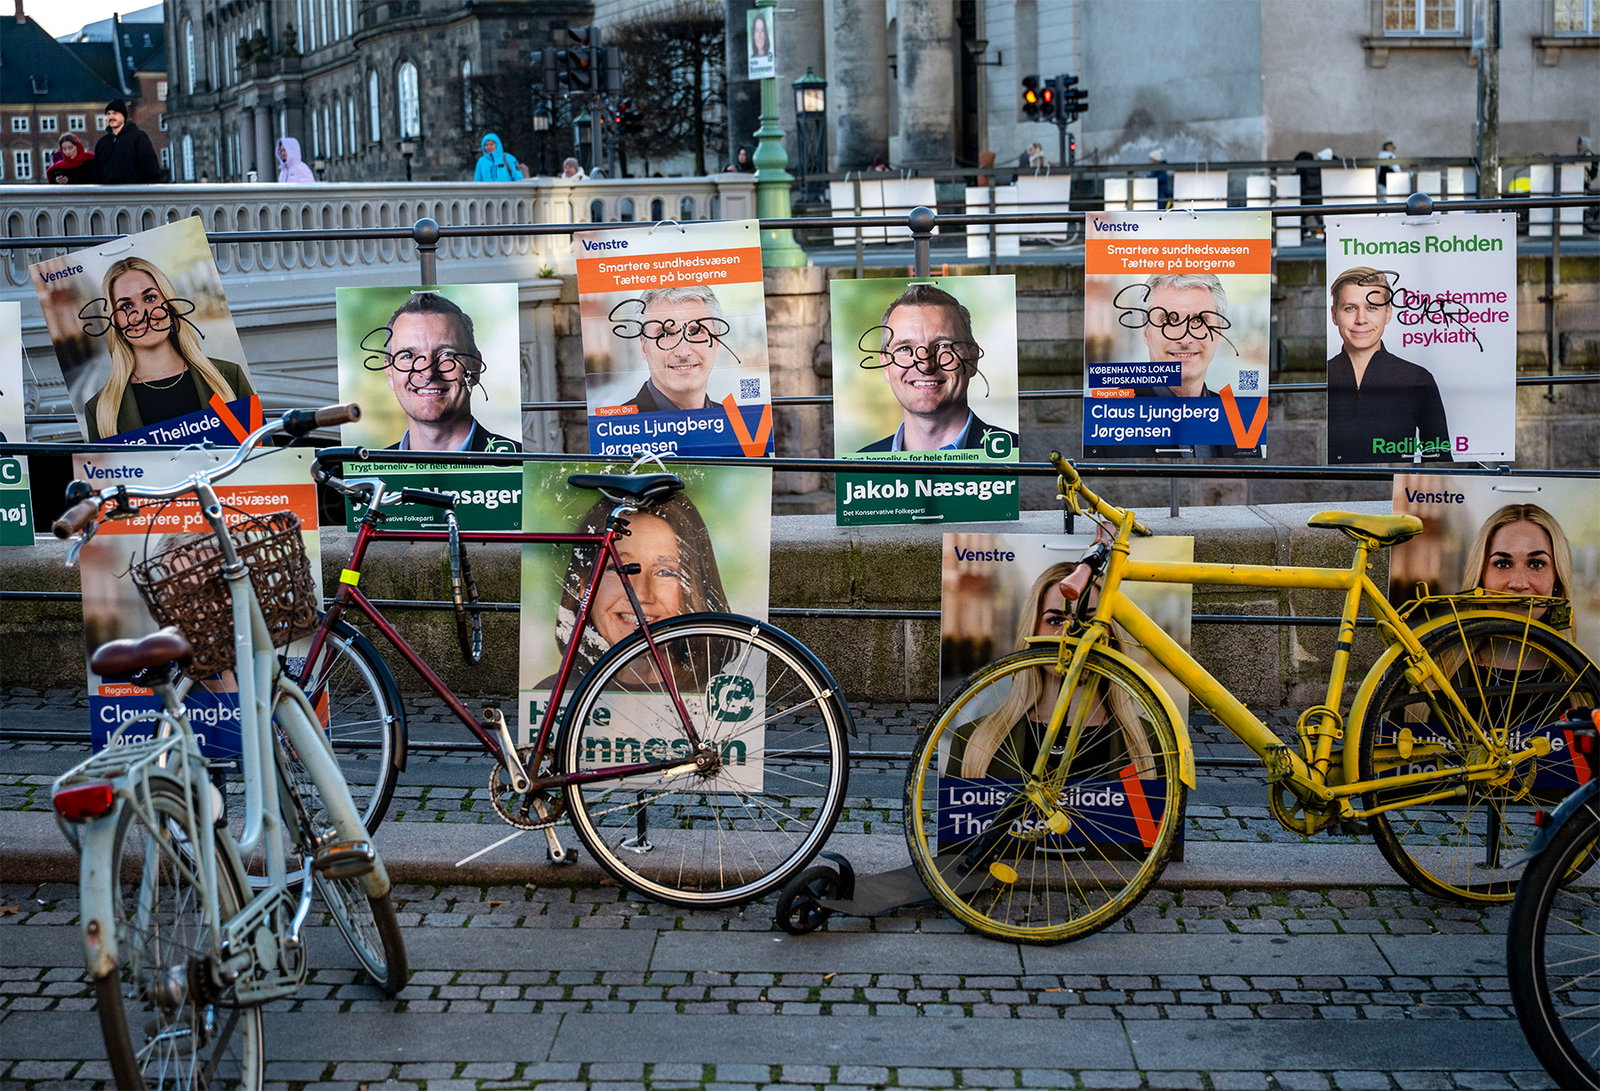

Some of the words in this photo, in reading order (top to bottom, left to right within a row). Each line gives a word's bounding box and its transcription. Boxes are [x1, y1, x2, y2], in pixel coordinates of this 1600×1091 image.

[1093, 219, 1139, 232] Venstre
[582, 238, 629, 251] Venstre
[1107, 244, 1159, 255] Smartere
[1161, 244, 1250, 255] sundhedsvæsen
[1339, 238, 1421, 255] Thomas
[1425, 234, 1503, 253] Rohden
[598, 260, 651, 273] Smartere
[653, 255, 740, 270] sundhedsvæsen
[1121, 258, 1165, 268] Tættere
[1168, 257, 1182, 270] på
[1185, 257, 1236, 270] borgerne
[40, 263, 84, 284] Venstre
[613, 272, 657, 285] Tættere
[660, 270, 675, 285] på
[677, 269, 727, 283] borgerne
[1402, 290, 1431, 305] Din
[1436, 290, 1507, 304] stemme
[1402, 310, 1425, 325] for
[1457, 308, 1509, 323] bedre
[1402, 328, 1477, 347] psykiatri
[1089, 365, 1147, 375] KØBENHAVNS
[1148, 364, 1181, 374] LOKALE
[1101, 376, 1169, 385] SPIDSKANDIDAT
[1096, 390, 1116, 398] Region
[600, 407, 621, 416] Region
[622, 406, 634, 414] Øst
[1091, 404, 1135, 419] Claus
[1139, 403, 1220, 423] Ljungberg
[149, 414, 221, 446] Theilade
[596, 421, 641, 437] Claus
[644, 416, 724, 438] Ljungberg
[1091, 424, 1171, 442] Jørgensen
[599, 440, 678, 456] Jørgensen
[1372, 436, 1451, 454] Radikale
[1456, 436, 1469, 452] B
[944, 452, 979, 461] familien
[83, 464, 144, 480] Venstre
[350, 463, 371, 473] Trygt
[843, 480, 909, 505] Jakob
[915, 479, 1016, 501] Næsager
[1405, 487, 1465, 504] Venstre
[105, 497, 172, 510] Sartere
[175, 493, 289, 507] sunedsvæsen
[183, 511, 203, 528] på
[404, 515, 434, 523] Folkeparti
[843, 509, 854, 517] Det
[855, 508, 894, 516] Konservative
[895, 507, 926, 517] Folkeparti
[954, 545, 1016, 562] Venstre
[104, 686, 132, 696] Region
[950, 786, 1008, 806] Louis
[1056, 786, 1125, 807] eilade
